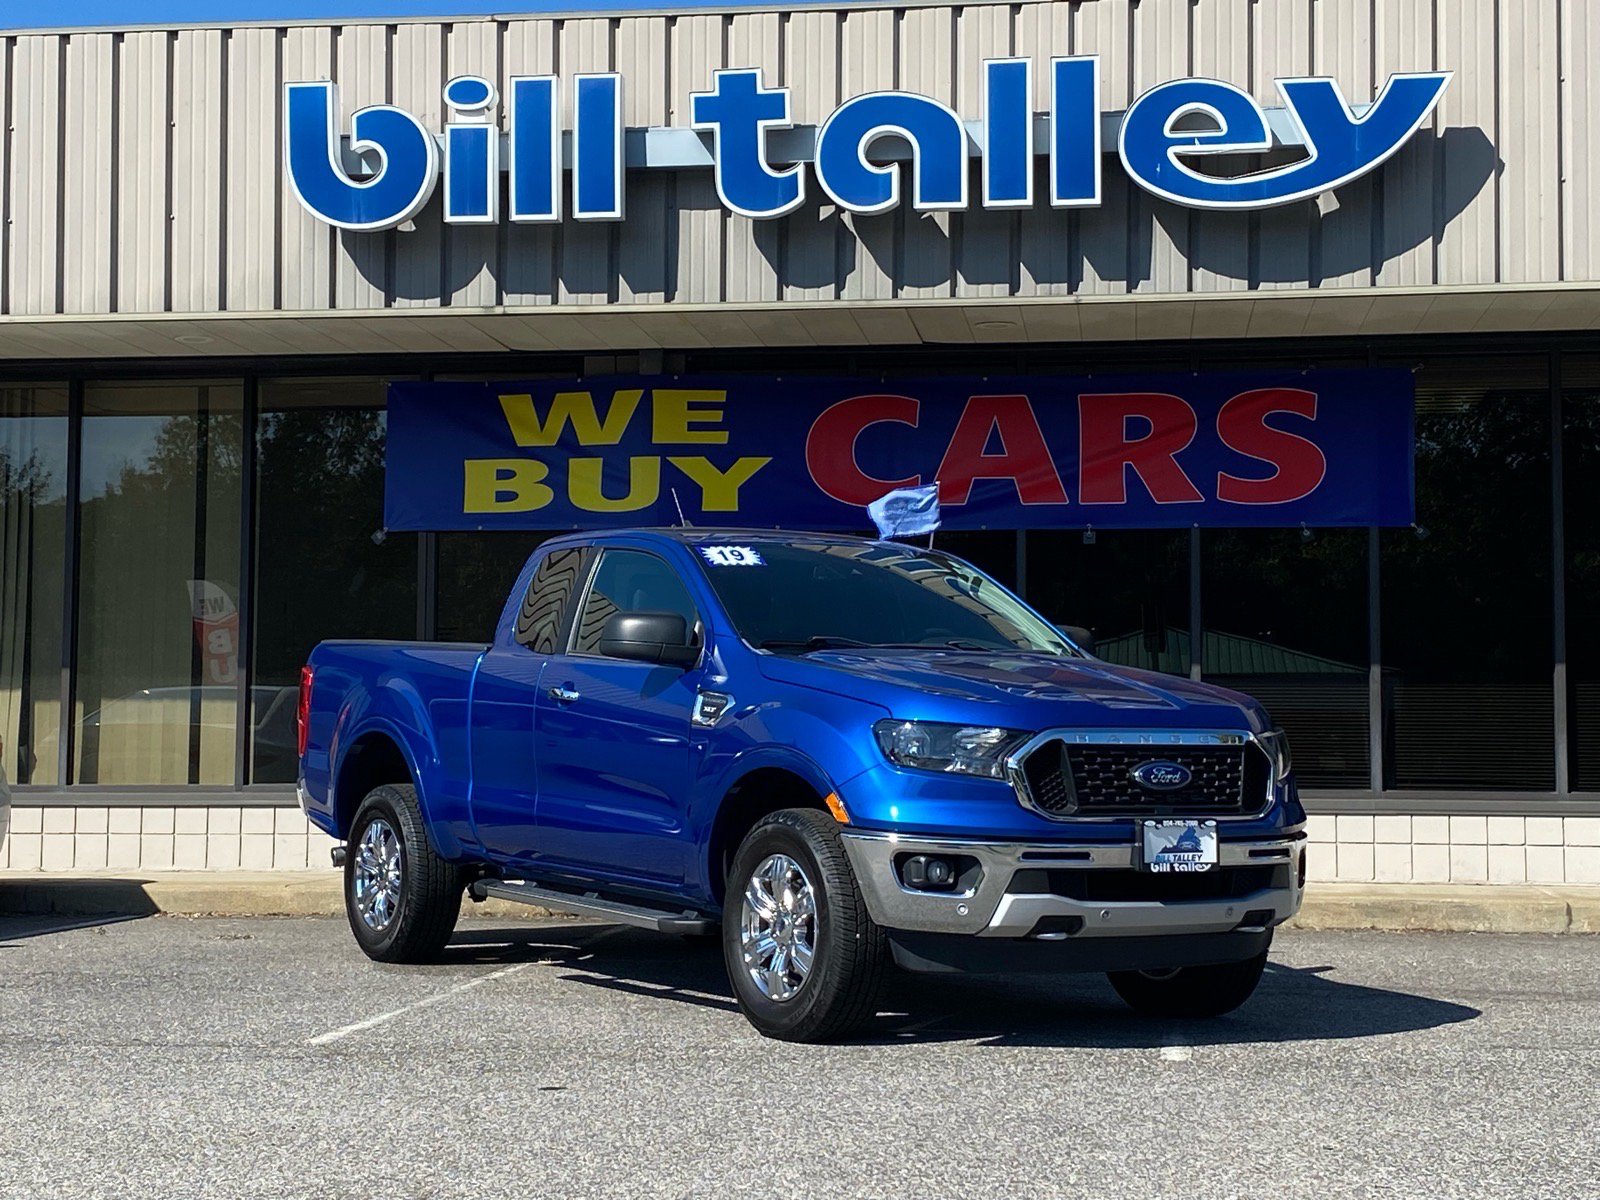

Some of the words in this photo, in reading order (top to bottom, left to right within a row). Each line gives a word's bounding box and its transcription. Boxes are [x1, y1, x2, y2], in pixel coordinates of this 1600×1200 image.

[283, 73, 626, 232] bill
[689, 55, 1454, 221] talley
[497, 389, 730, 447] WE
[805, 388, 1328, 507] CARS
[463, 456, 773, 514] BUY
[717, 550, 744, 561] 19
[1151, 766, 1181, 783] Ford
[1150, 862, 1170, 873] bill
[1173, 862, 1212, 873] talley
[1173, 854, 1202, 863] TALLEY
